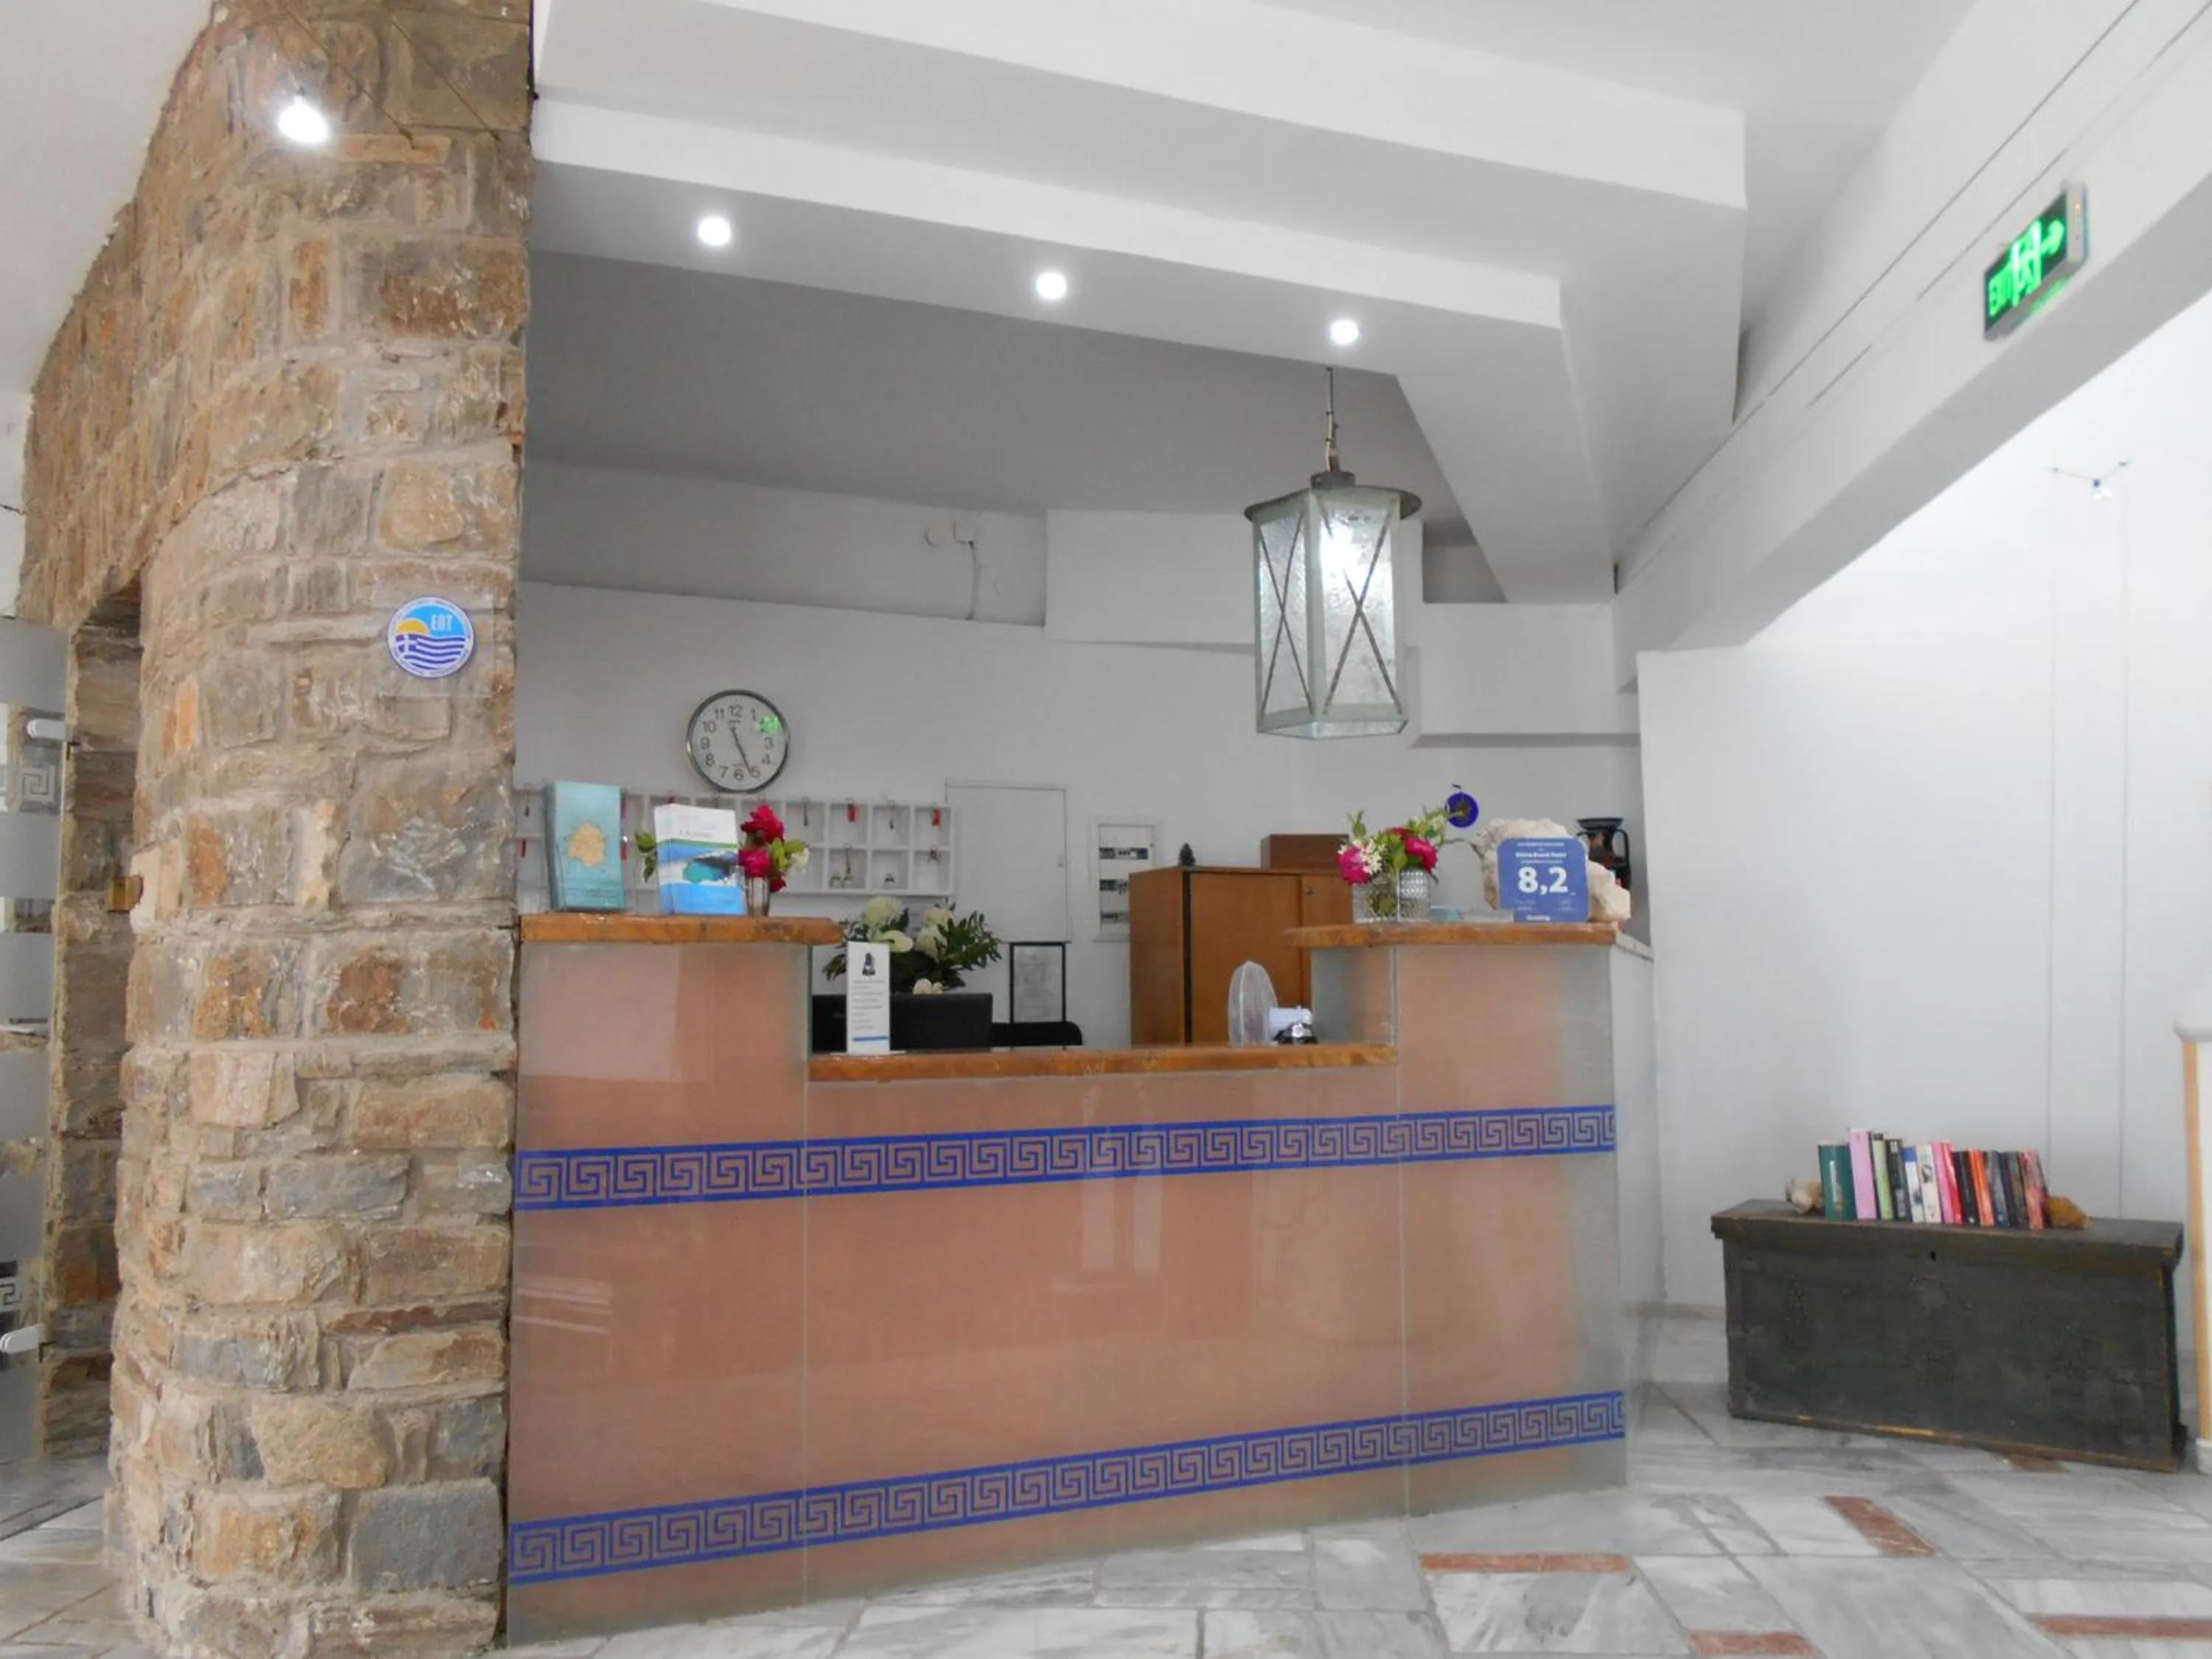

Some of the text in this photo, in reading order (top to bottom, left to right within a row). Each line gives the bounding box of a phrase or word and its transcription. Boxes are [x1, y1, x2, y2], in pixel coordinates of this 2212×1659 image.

[714, 708, 725, 720] 11
[728, 704, 743, 717] 12
[751, 708, 757, 720] 1
[702, 720, 717, 733] 10
[700, 737, 710, 750] 9
[764, 737, 773, 750] 3
[705, 753, 715, 767] 8
[761, 754, 771, 765] 4
[719, 766, 728, 779] 7
[733, 768, 744, 781] 6
[751, 765, 760, 778] 5
[1517, 866, 1569, 895] 8,2
